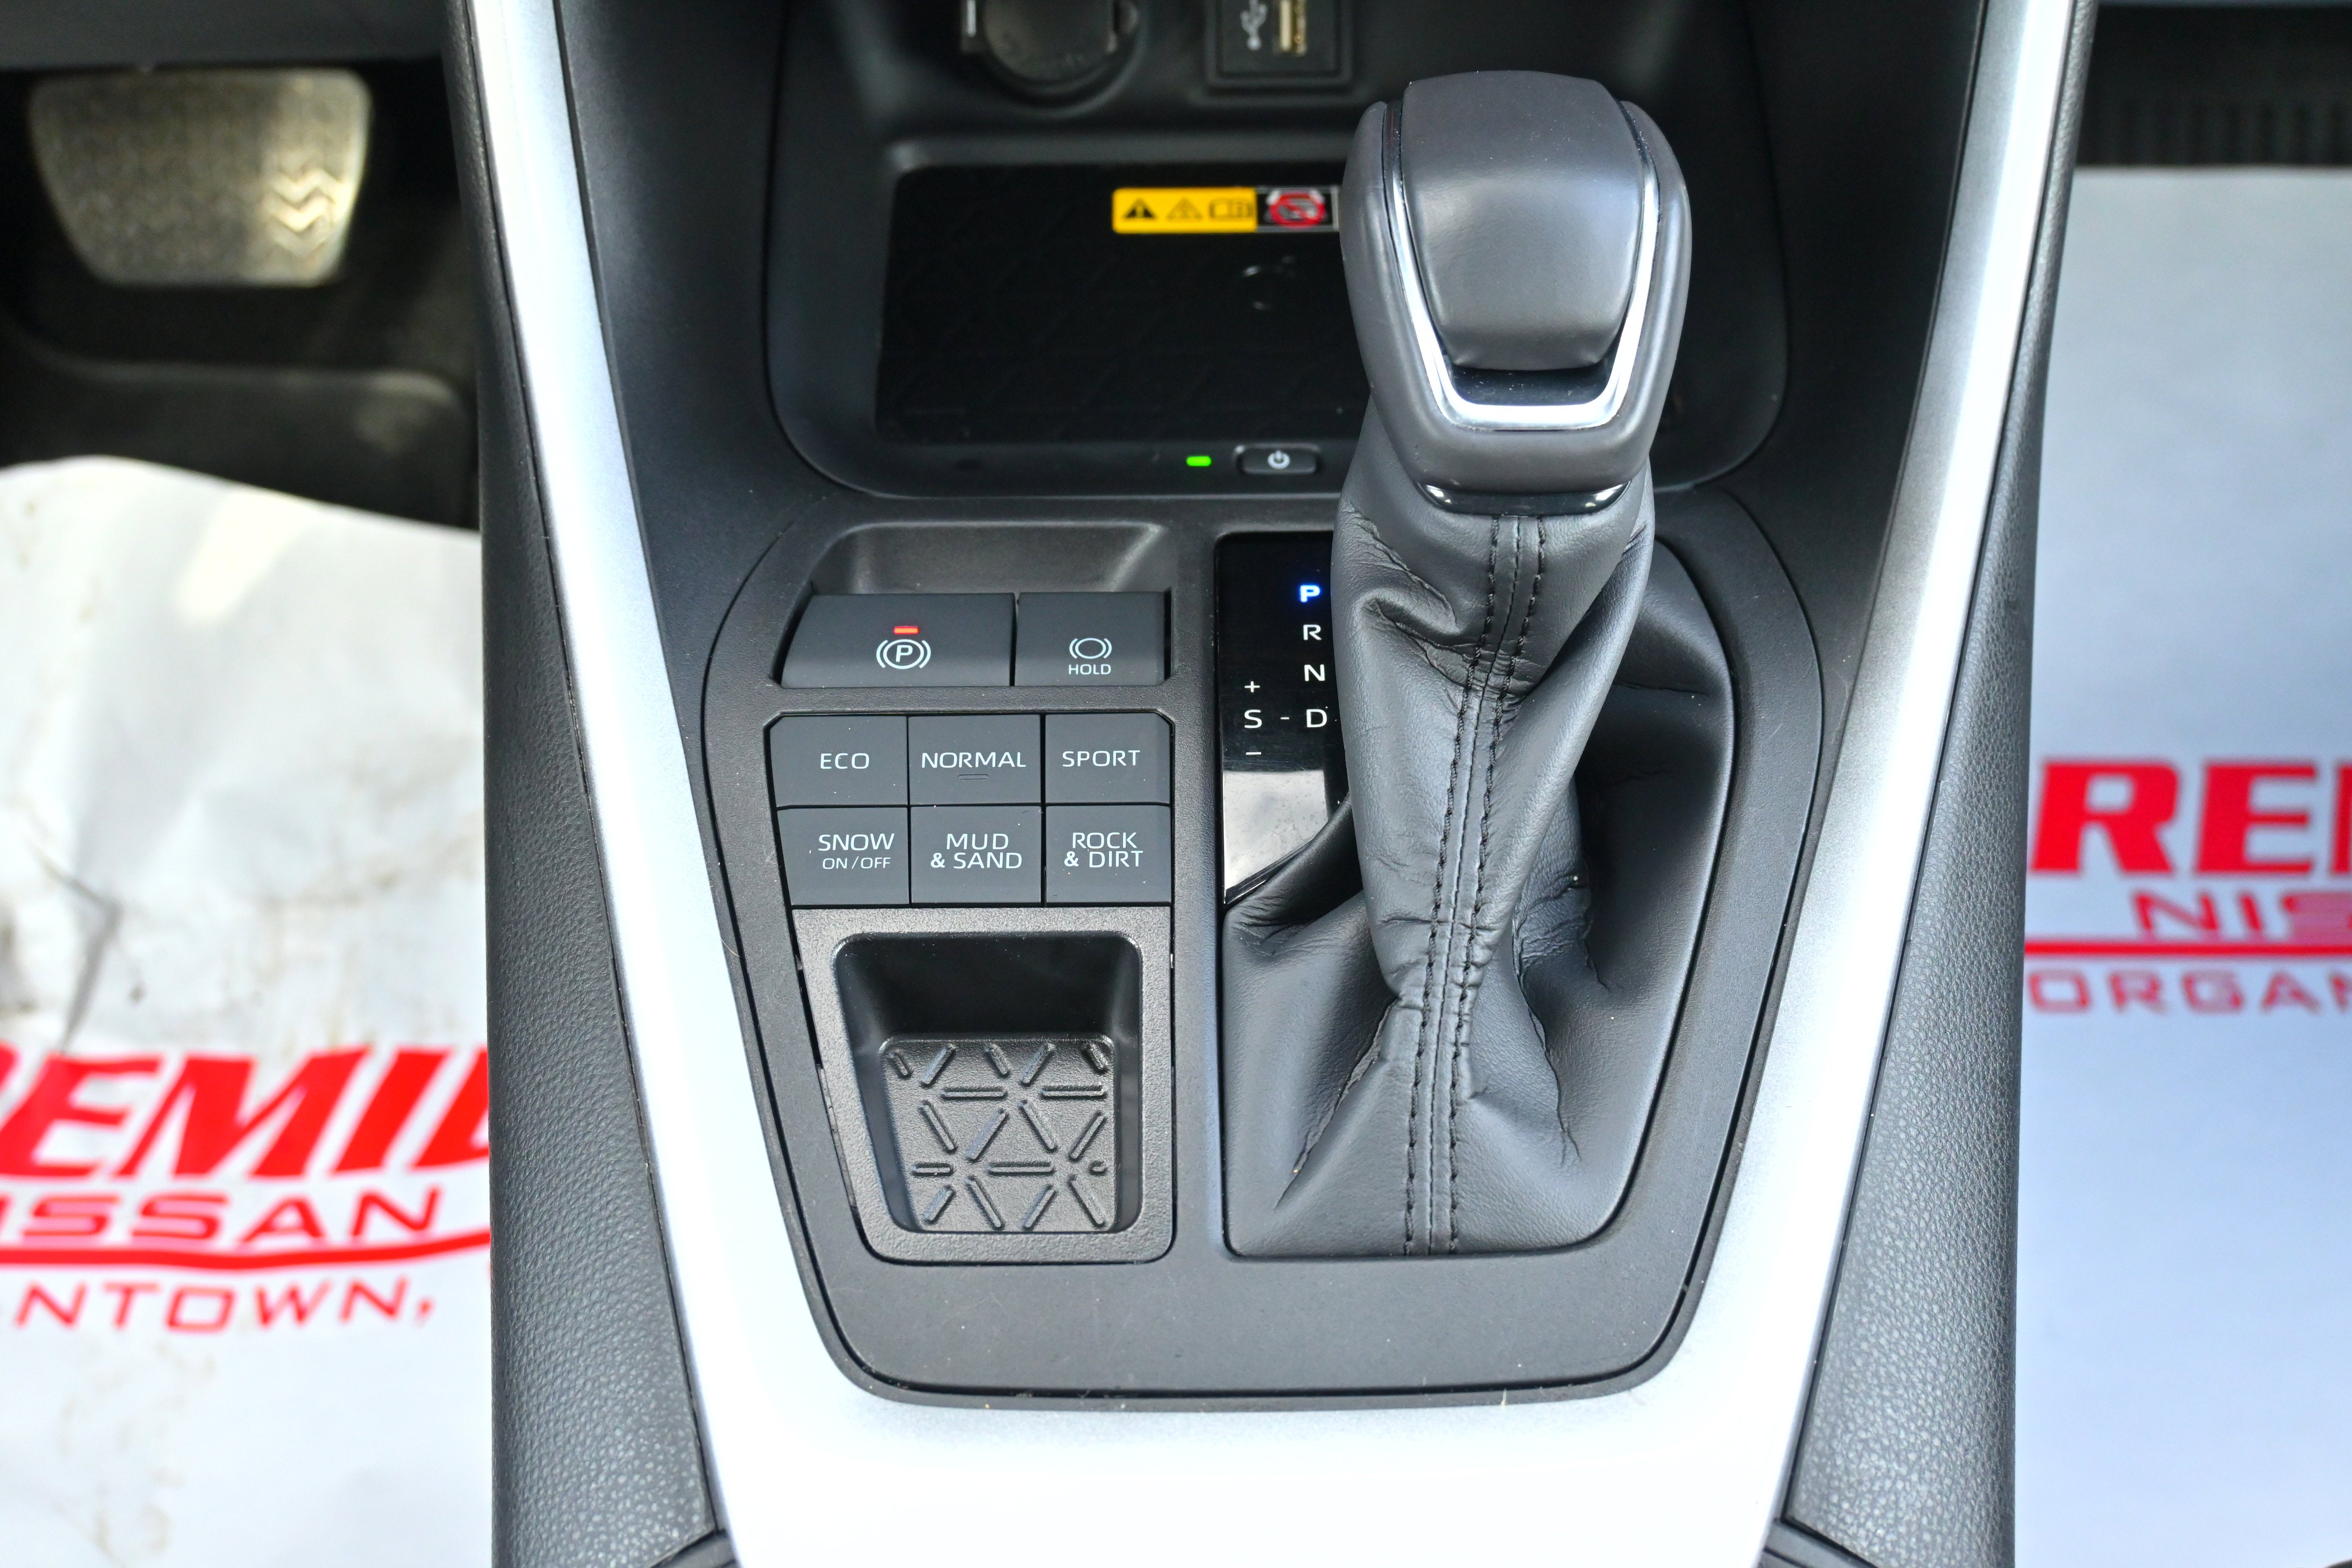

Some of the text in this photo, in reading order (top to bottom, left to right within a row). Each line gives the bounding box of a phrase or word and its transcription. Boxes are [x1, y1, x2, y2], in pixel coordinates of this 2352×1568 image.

[1299, 585, 1320, 603] P
[1303, 624, 1322, 641] R
[1068, 663, 1112, 676] HOLD
[1304, 664, 1326, 682] N
[1244, 709, 1263, 729] S
[1306, 708, 1328, 728] D
[819, 752, 870, 770] ECO
[921, 751, 1027, 769] NORMAL
[1062, 749, 1141, 768] SPORT
[2030, 760, 2352, 875] RE
[817, 833, 896, 852] SNOW
[946, 833, 1009, 851] MUD
[1072, 831, 1138, 849] ROCK
[930, 851, 1023, 870] & SAND
[1063, 850, 1144, 868] & DIRT
